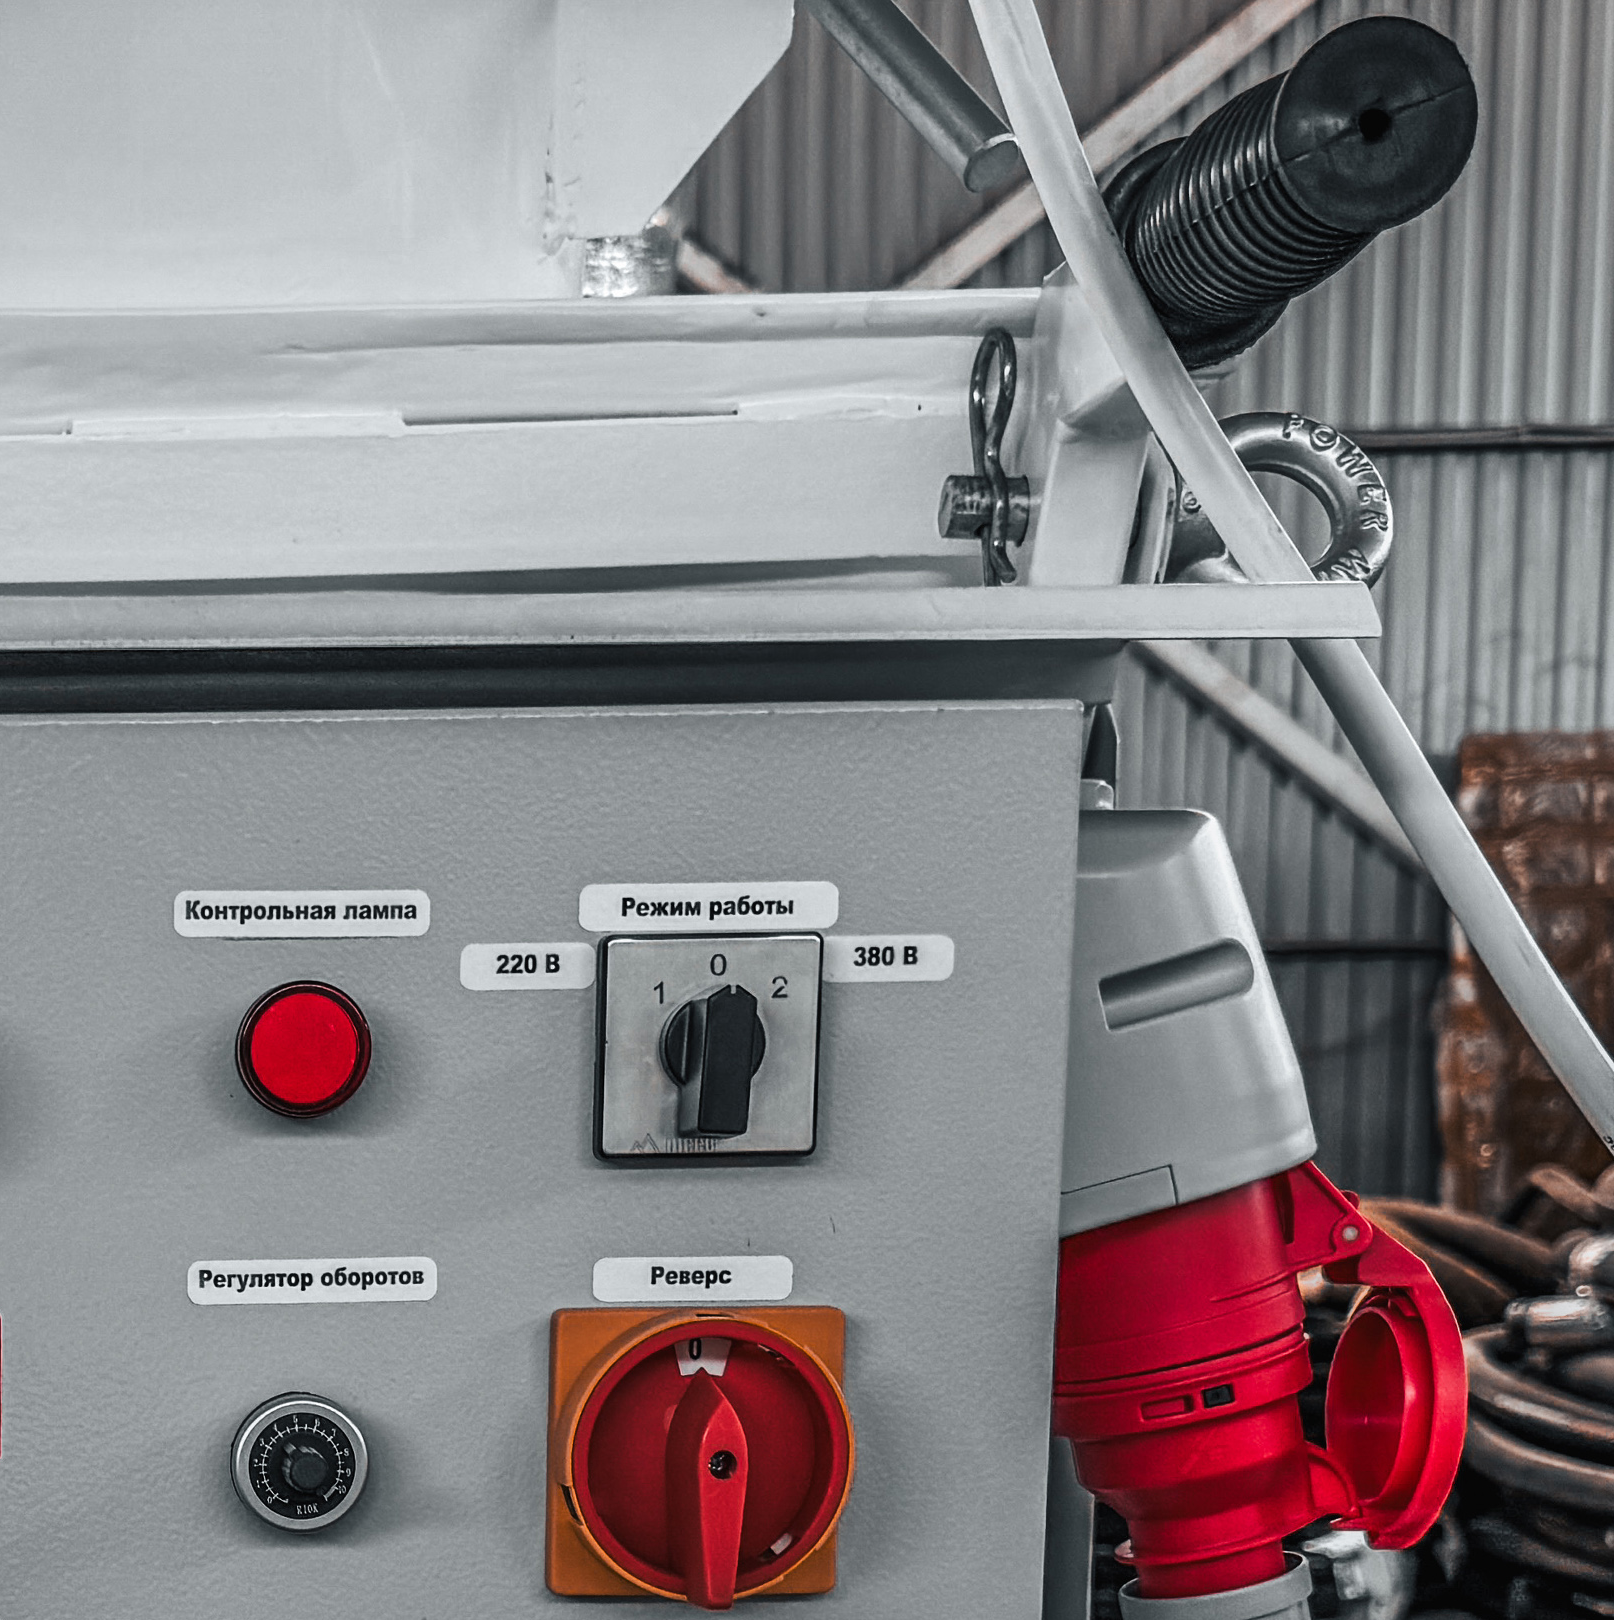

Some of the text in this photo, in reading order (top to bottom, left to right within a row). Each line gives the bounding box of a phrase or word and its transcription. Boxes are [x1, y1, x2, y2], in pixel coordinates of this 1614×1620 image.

[185, 900, 417, 925] Контрольная лампа
[621, 895, 794, 921] Режим работы
[496, 953, 560, 974] 220 В
[853, 945, 918, 967] 380 В
[653, 953, 789, 1005] 1 0 2
[198, 1266, 425, 1293] Регулятор оборотов
[650, 1266, 732, 1288] Реверс
[688, 1338, 702, 1361] 0
